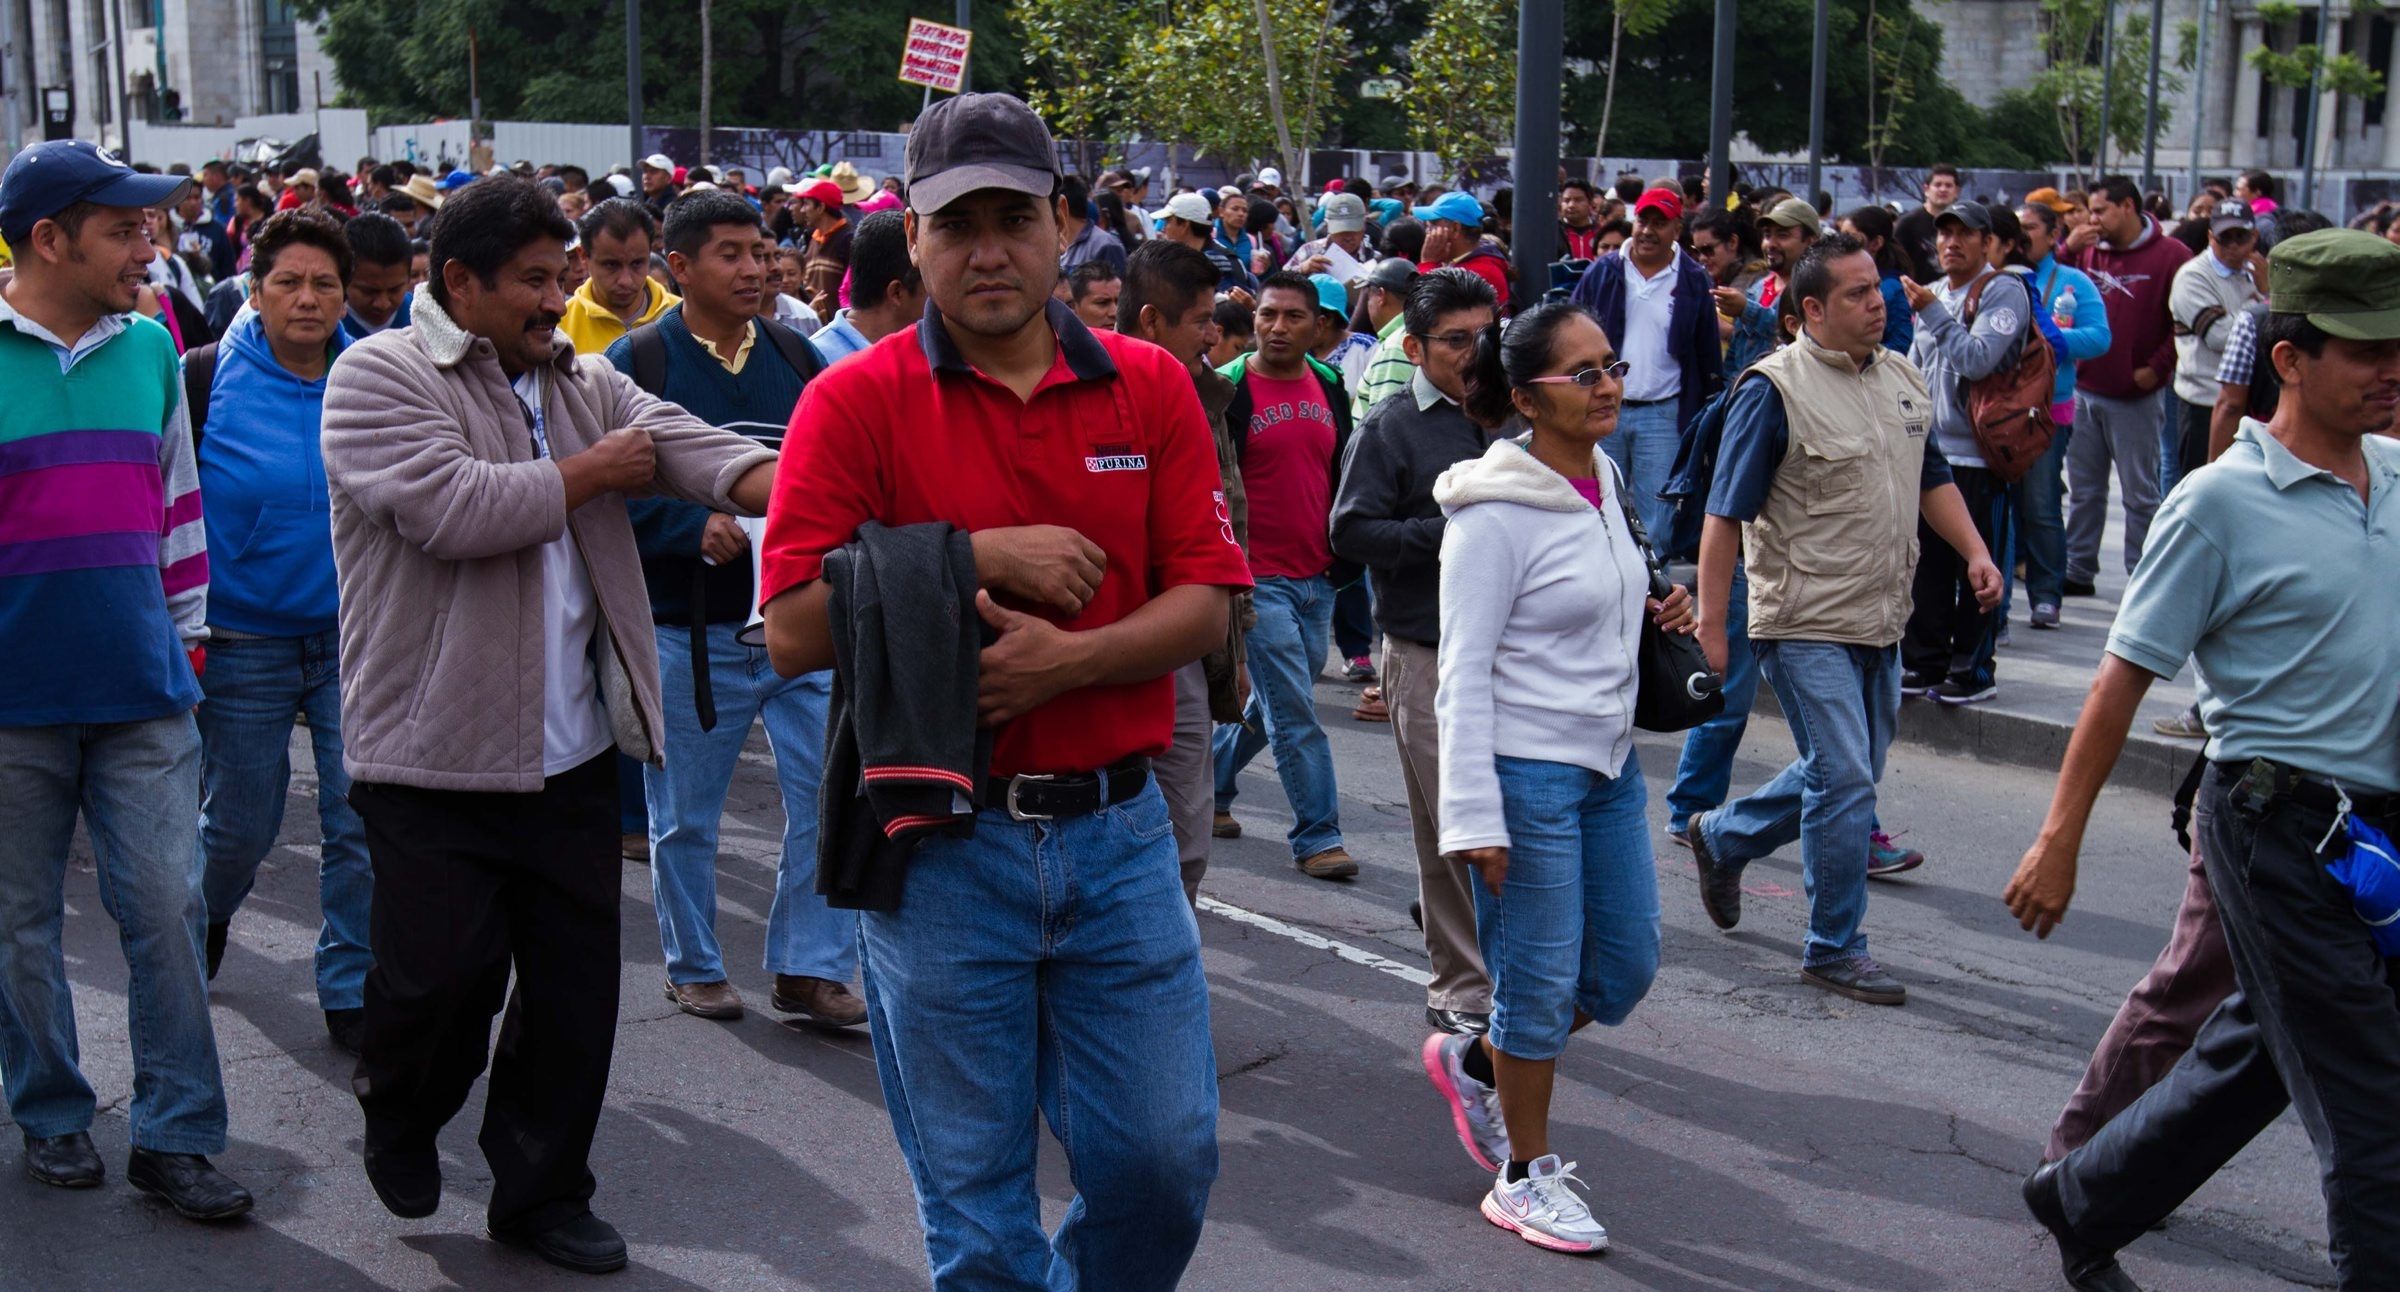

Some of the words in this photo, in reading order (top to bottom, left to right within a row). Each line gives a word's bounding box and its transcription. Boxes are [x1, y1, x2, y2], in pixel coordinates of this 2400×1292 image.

[1249, 402, 1294, 434] RED
[1298, 401, 1334, 428] SOX
[1098, 457, 1145, 469] PURINA
